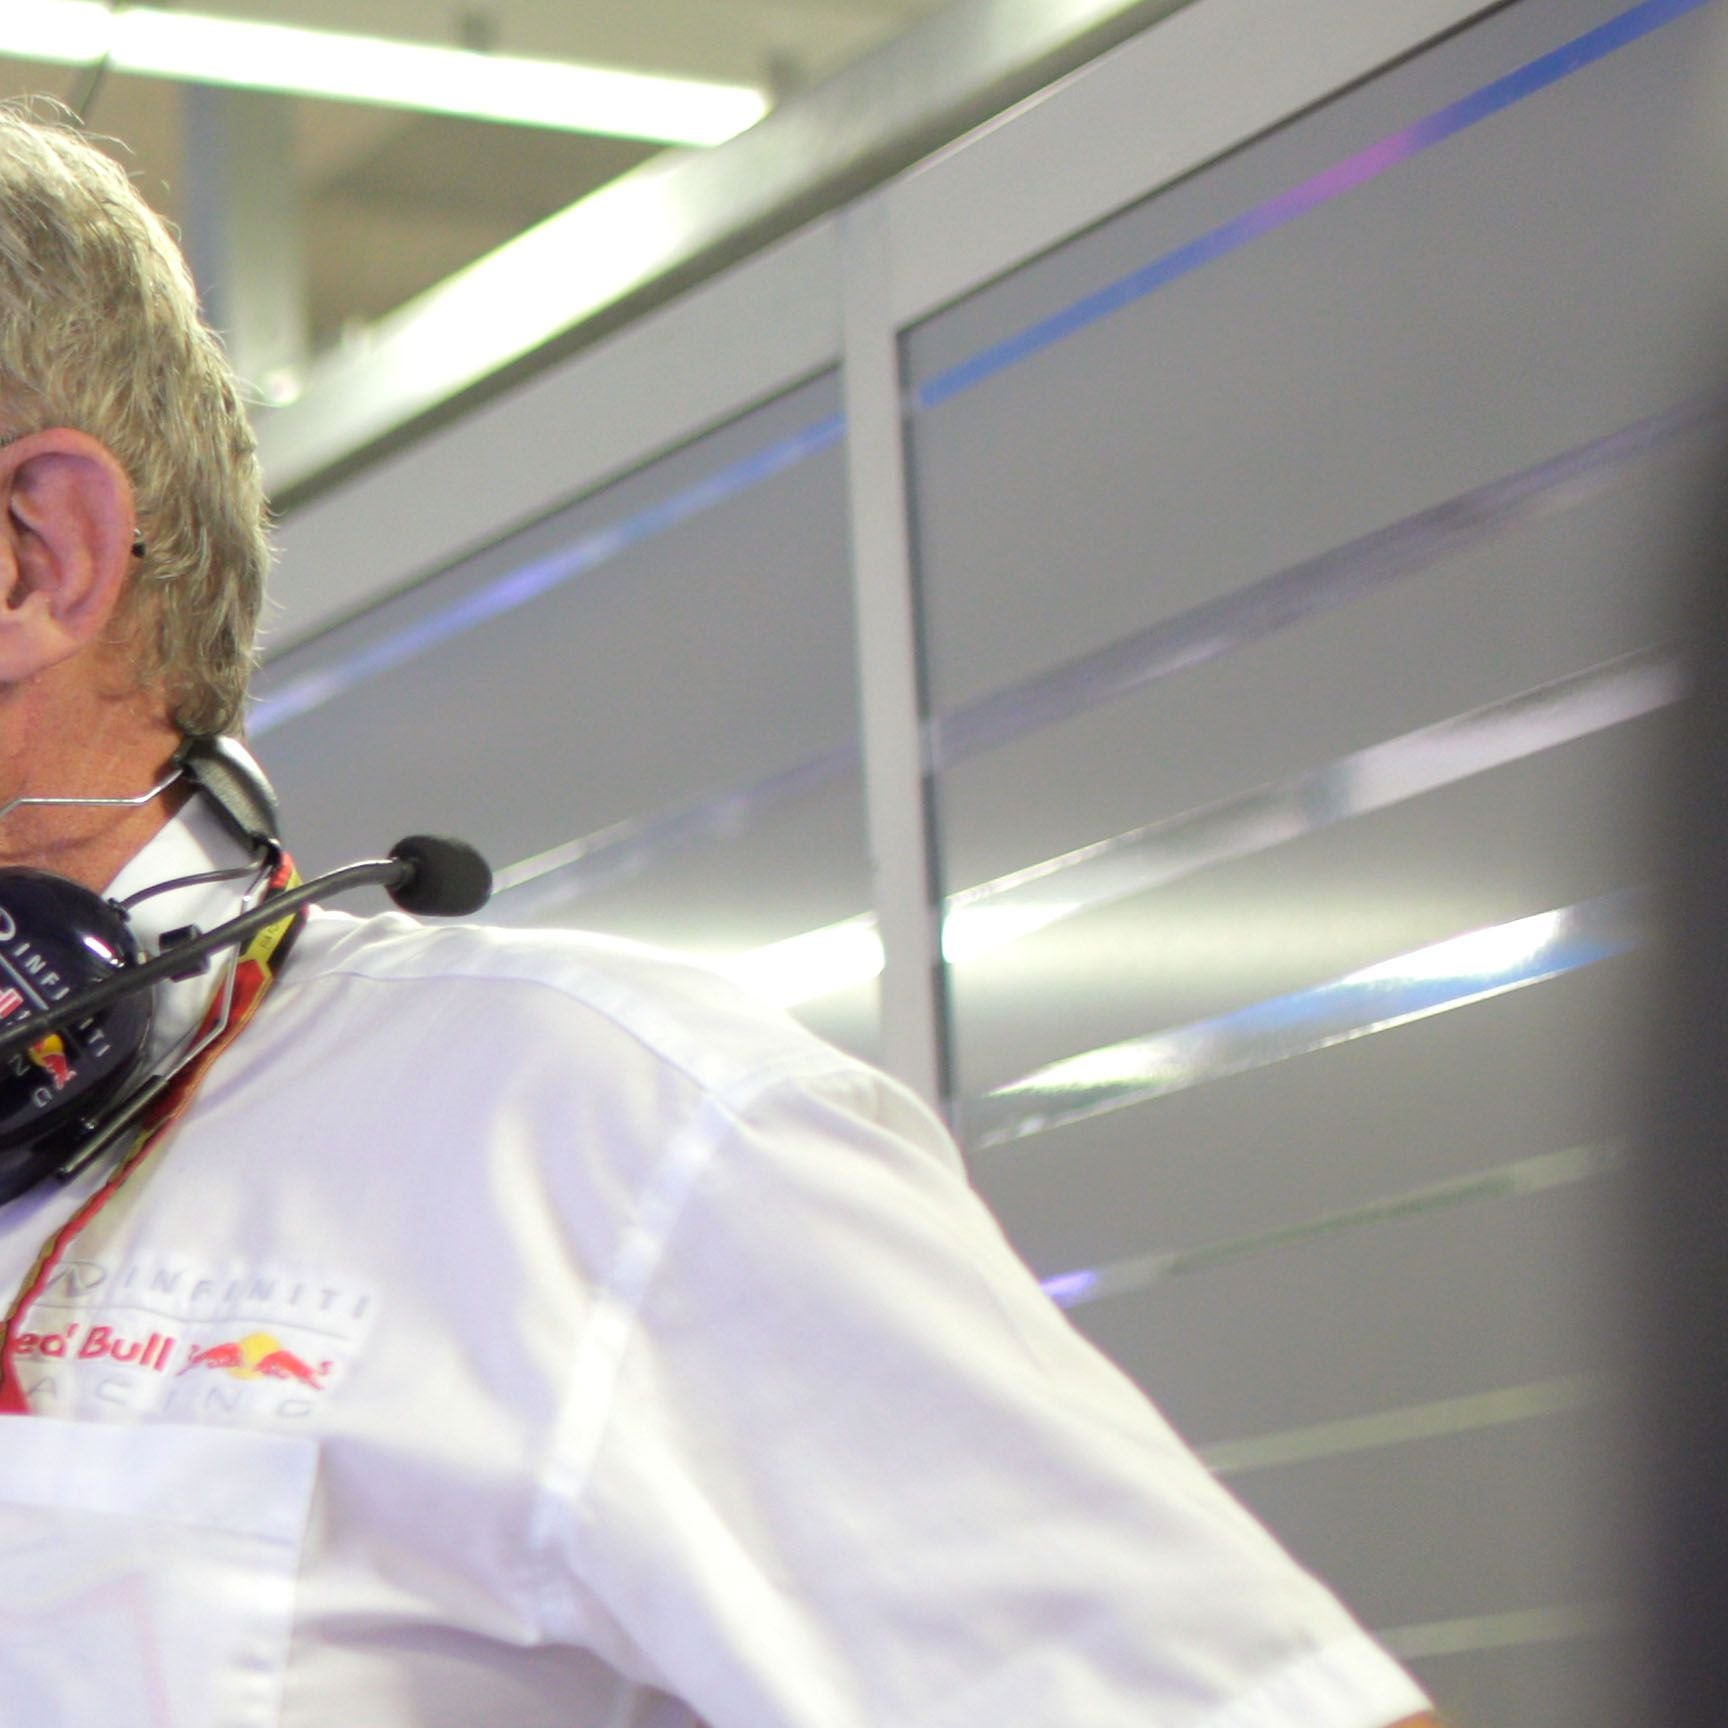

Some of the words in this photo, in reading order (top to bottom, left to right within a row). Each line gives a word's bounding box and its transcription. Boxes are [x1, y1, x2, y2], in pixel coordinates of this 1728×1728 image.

[13, 942, 111, 1058] INFIITI
[123, 1264, 371, 1319] INFINITI
[14, 1322, 78, 1359] ed
[77, 1324, 177, 1373] Bull
[28, 1375, 312, 1419] ACING
